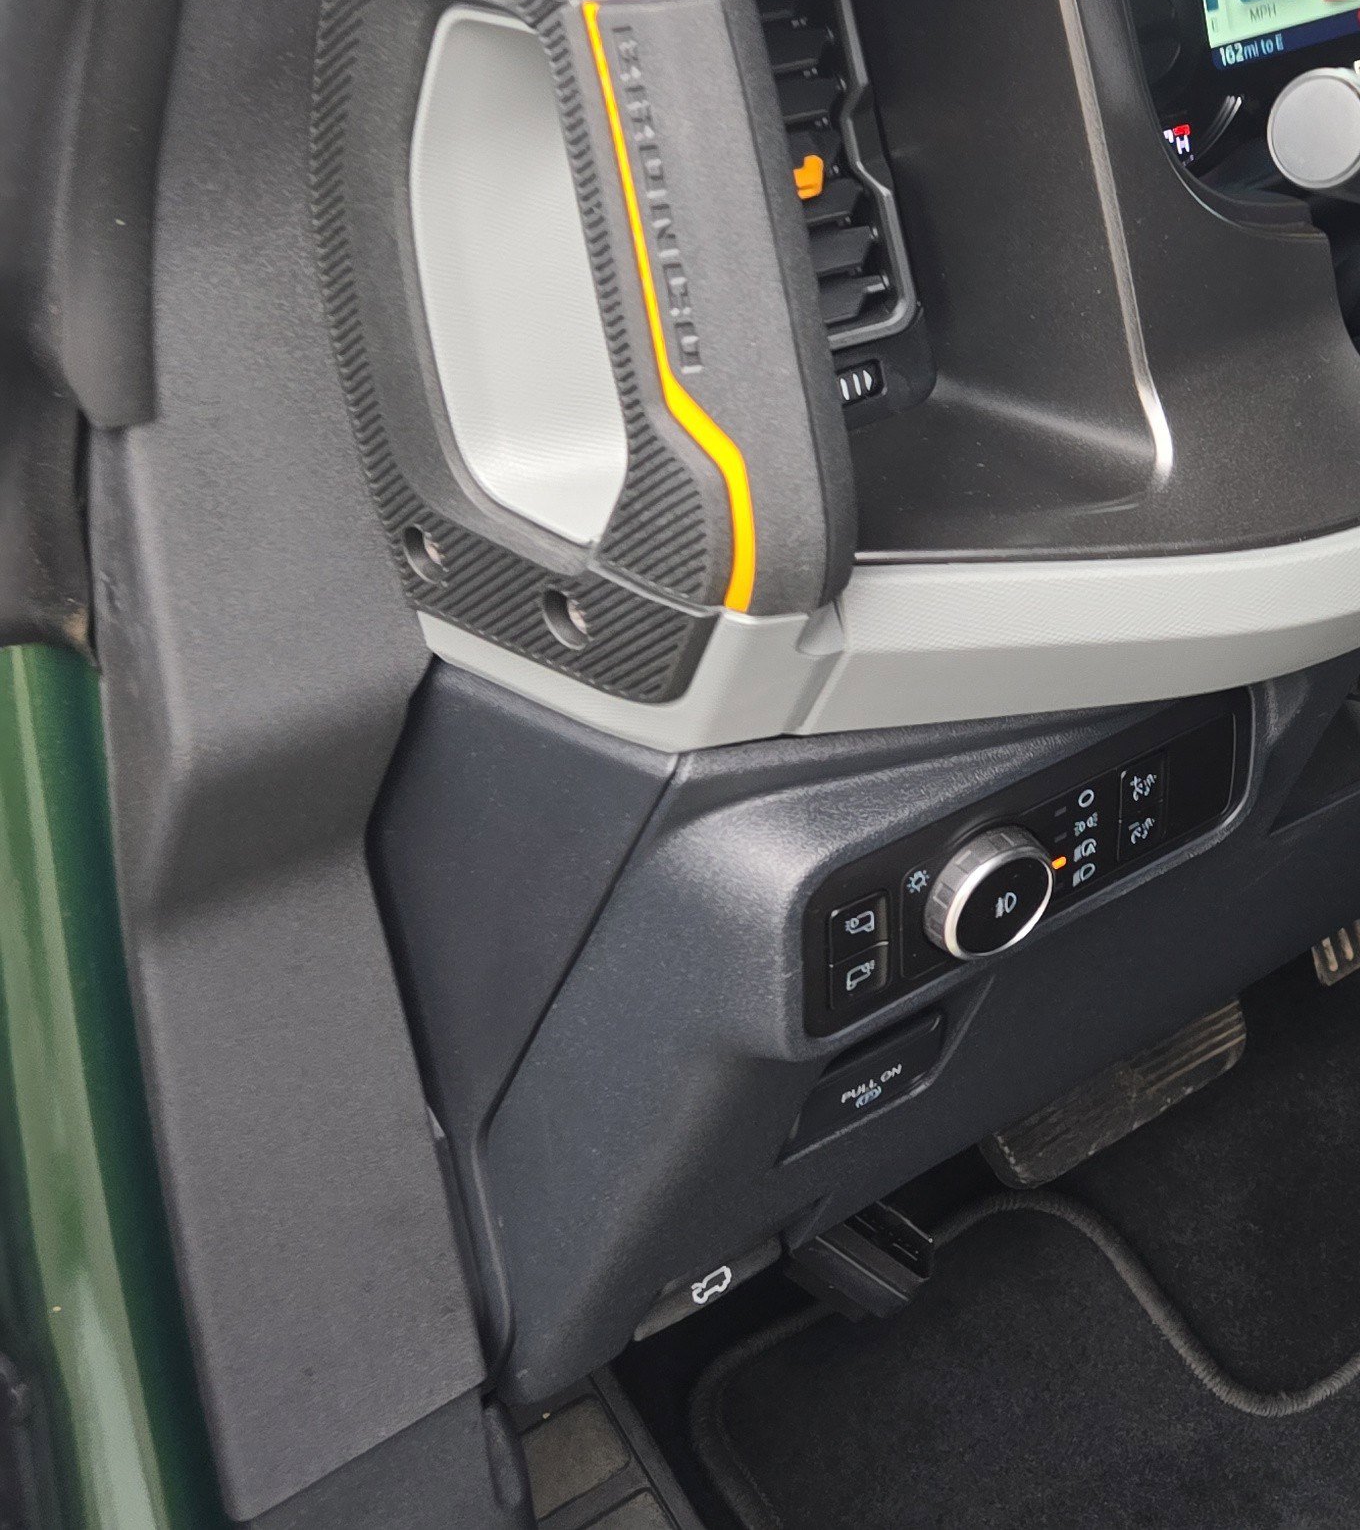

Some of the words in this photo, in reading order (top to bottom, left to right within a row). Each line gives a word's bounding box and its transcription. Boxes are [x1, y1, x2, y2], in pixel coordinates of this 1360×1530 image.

[1249, 4, 1277, 23] MPH
[1260, 38, 1274, 55] to
[841, 1079, 878, 1103] PULL
[881, 1063, 902, 1083] ON
